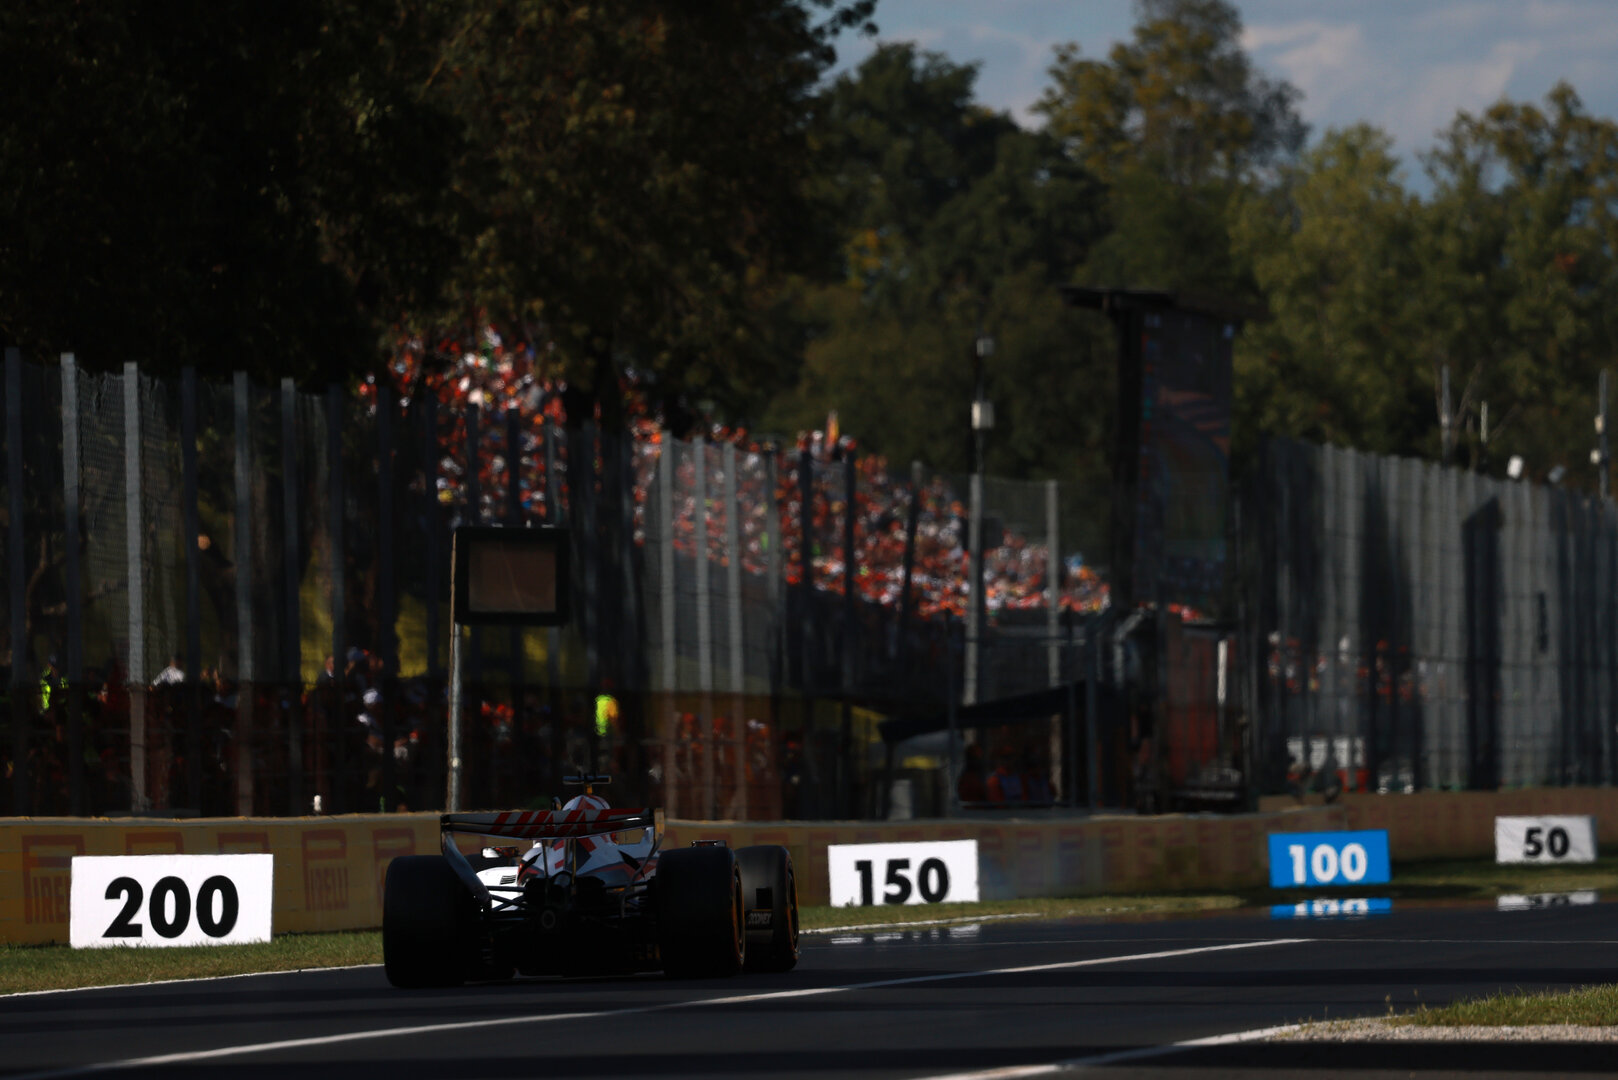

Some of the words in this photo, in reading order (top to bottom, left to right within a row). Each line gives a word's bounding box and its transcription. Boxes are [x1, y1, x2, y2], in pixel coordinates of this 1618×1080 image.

[1288, 842, 1368, 885] 100
[1525, 827, 1569, 858] 50
[855, 857, 949, 906] 150
[102, 875, 239, 938] 200
